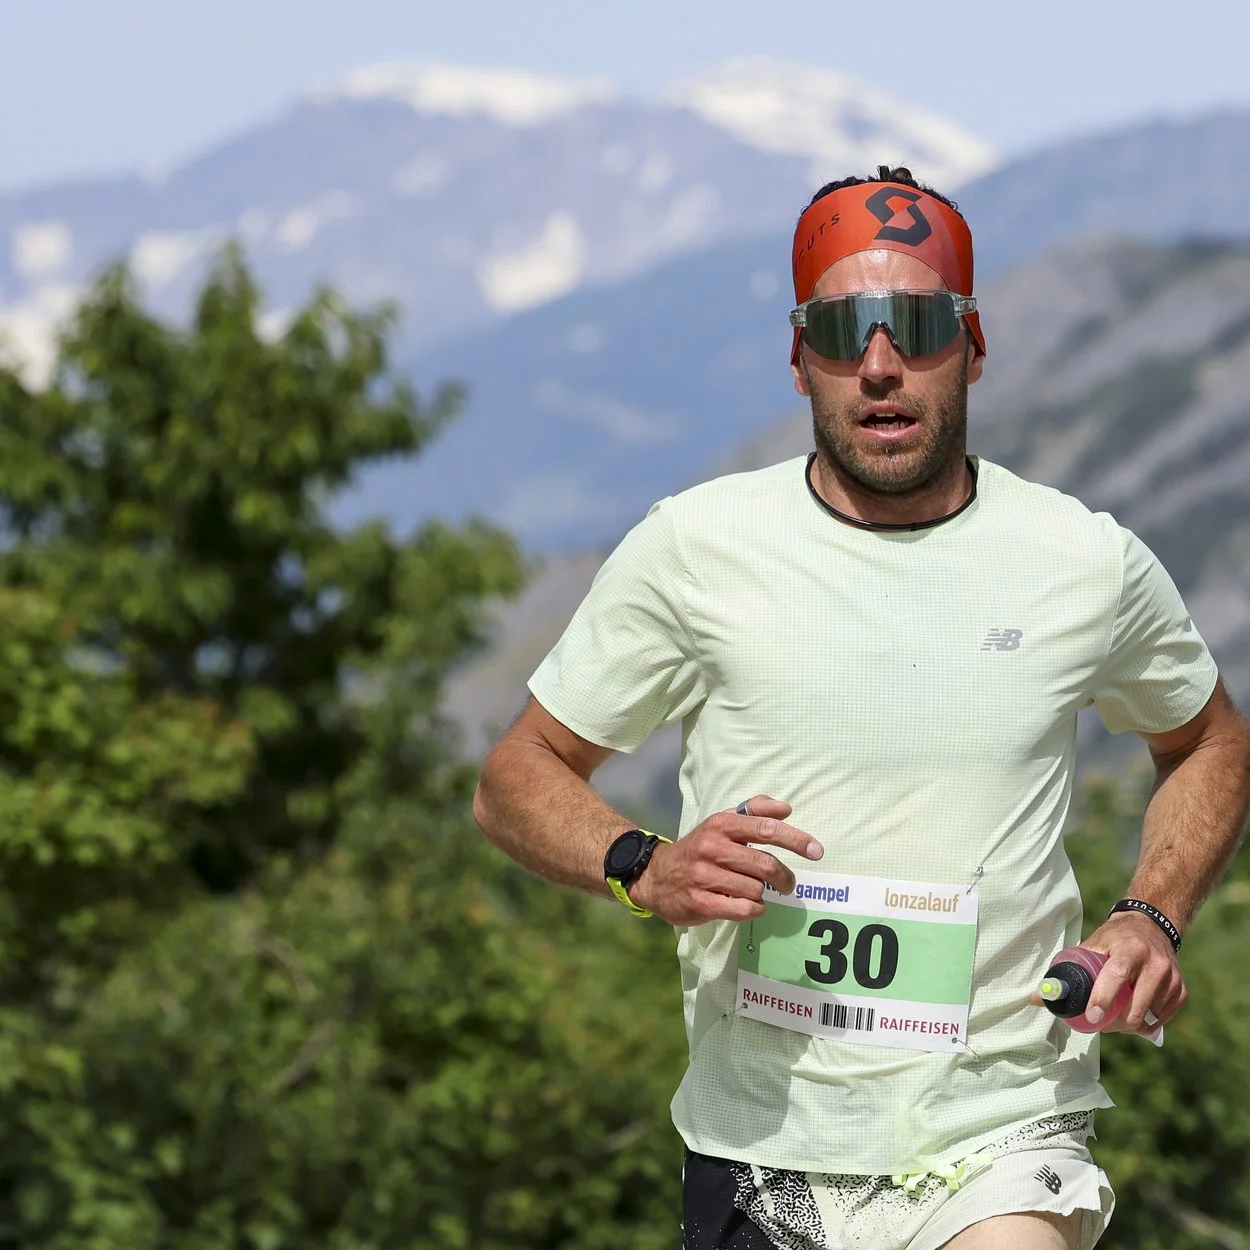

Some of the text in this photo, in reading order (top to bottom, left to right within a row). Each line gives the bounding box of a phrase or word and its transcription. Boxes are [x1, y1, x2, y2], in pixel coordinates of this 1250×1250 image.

[796, 883, 850, 903] gampel
[884, 888, 960, 913] lonzalauf
[804, 919, 899, 990] 30
[743, 988, 960, 1035] RAIFFEISEN RAIFFEISEN
